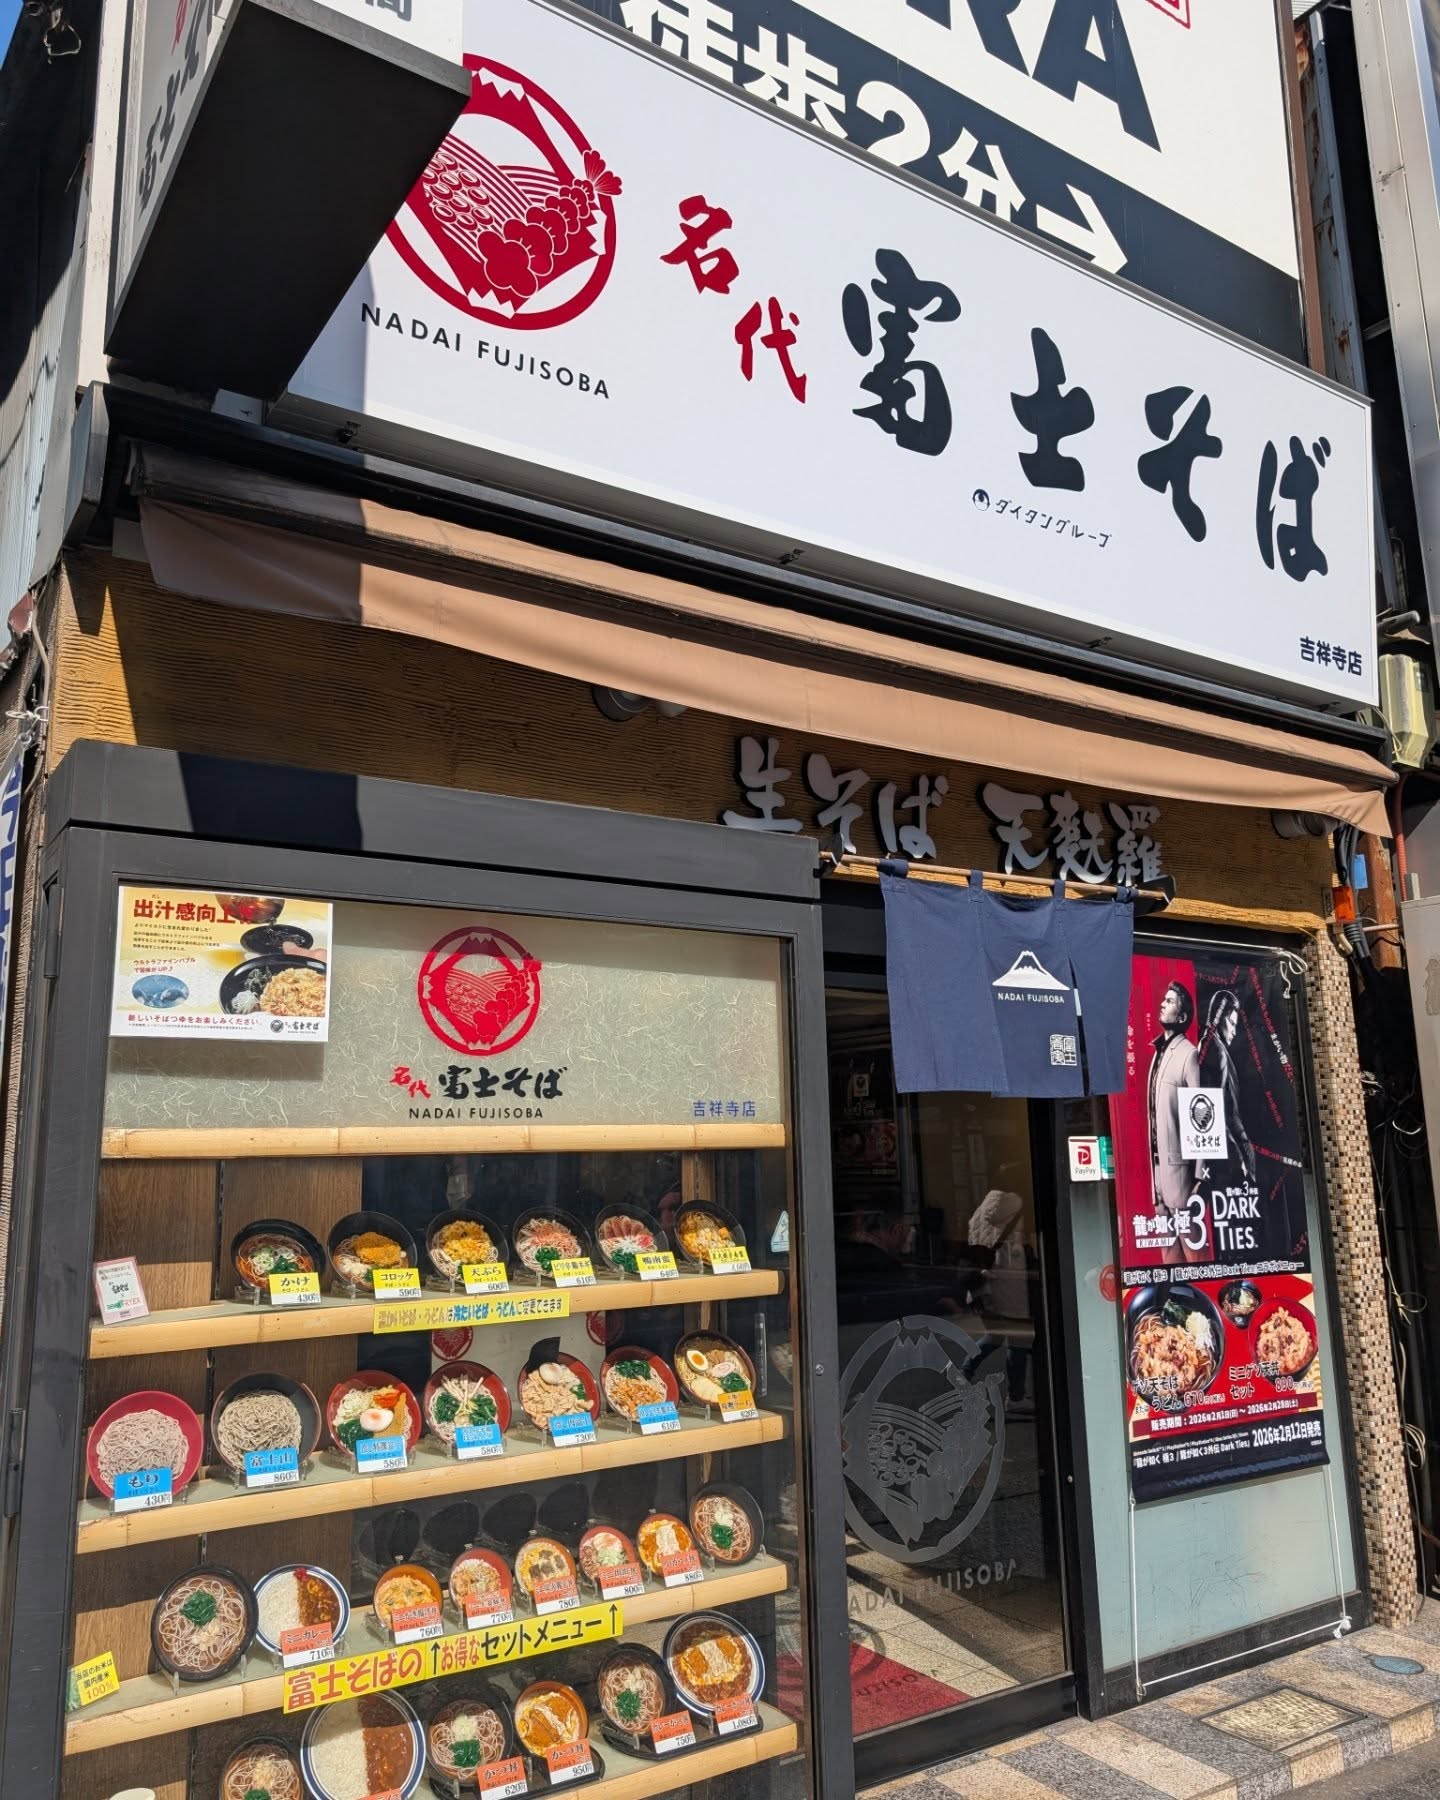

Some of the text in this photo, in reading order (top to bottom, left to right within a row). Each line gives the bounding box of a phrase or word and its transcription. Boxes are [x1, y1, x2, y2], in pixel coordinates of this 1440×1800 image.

[621, 0, 1026, 219] 徒歩2分
[361, 303, 609, 399] NADAI FUJISOBA
[660, 195, 1331, 582] 名代 富士そば
[996, 499, 1112, 547] ダイタングループ
[1300, 636, 1362, 676] 吉祥寺店
[722, 736, 949, 859] 生そば
[997, 993, 1064, 1003] NADAI FUJISOBA
[389, 1065, 568, 1099] 名代 富士そば
[409, 1107, 543, 1119] NADAI FUJISOBA
[693, 1100, 756, 1117] 吉祥寺店
[1075, 1167, 1096, 1176] PayPay
[1212, 1191, 1261, 1219] DARK
[1140, 1238, 1170, 1247] KIWAMI
[380, 1272, 414, 1281] コロッケ
[472, 1267, 501, 1276] 天ぷら
[281, 1277, 310, 1286] かけ
[488, 1282, 507, 1291] 600円
[576, 1276, 595, 1284] 610円
[297, 1292, 320, 1303] 430円
[399, 1288, 420, 1297] 590円
[1230, 1382, 1255, 1399] セット
[1152, 1393, 1182, 1411] うどん
[661, 1421, 681, 1430] 610円
[575, 1433, 595, 1443] 730円
[1252, 1421, 1321, 1447] 2026年2月12日発売
[481, 1446, 503, 1455] 580円
[384, 1458, 406, 1468] 580円
[128, 1474, 159, 1487] もり
[273, 1469, 299, 1483] 860円
[144, 1494, 171, 1506] 430円
[624, 1584, 643, 1594] 800円
[559, 1598, 580, 1608] 780円
[491, 1612, 512, 1623] 770円
[285, 1629, 329, 1644] ミニカレー
[420, 1626, 442, 1637] 760円
[441, 1617, 602, 1671] お得な セットメニュー
[310, 1647, 333, 1660] 710円
[76, 1658, 113, 1681] 当店のお米は
[84, 1671, 110, 1688] 国内産米
[287, 1648, 422, 1710] 富士そばの
[85, 1680, 115, 1700] 100%
[733, 1716, 755, 1729] 1,080円
[676, 1733, 694, 1746] 750円
[552, 1745, 583, 1759] かつ丼
[484, 1762, 518, 1779] かつ丼
[573, 1764, 593, 1776] 950円
[505, 1781, 527, 1795] 620円
